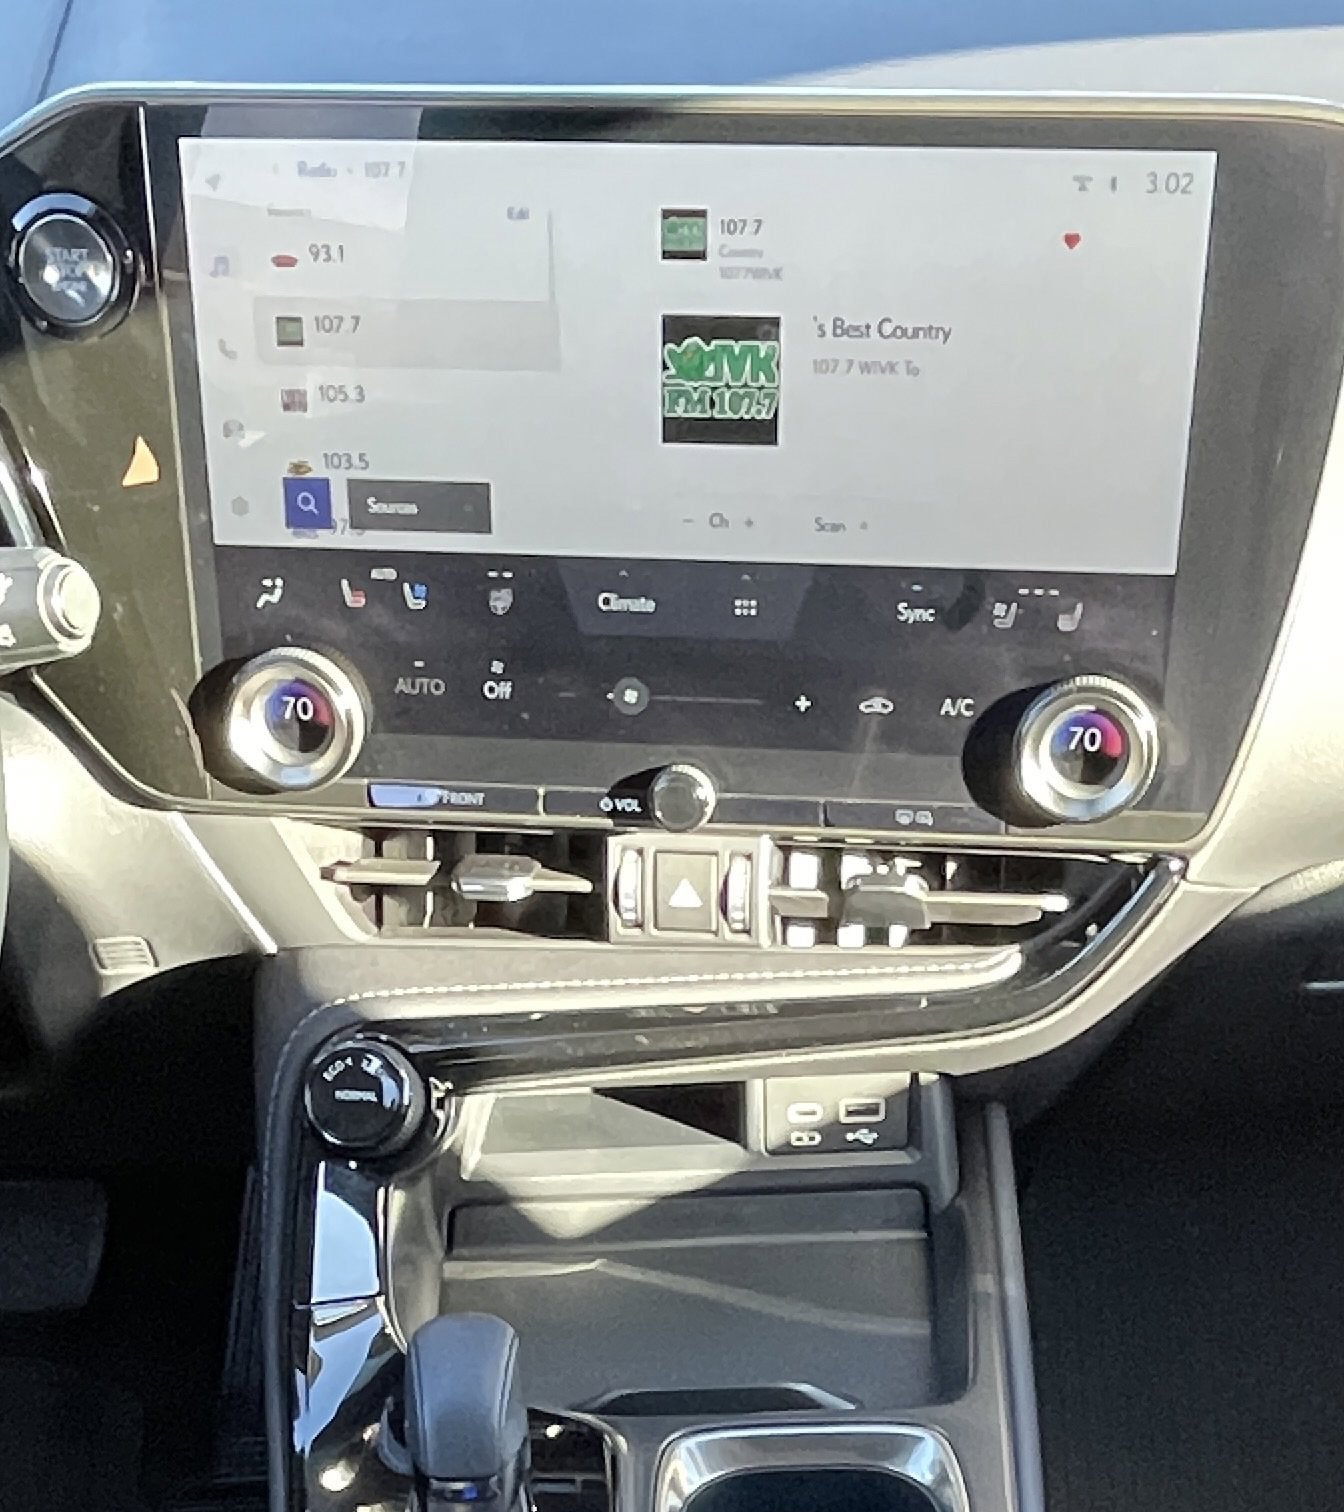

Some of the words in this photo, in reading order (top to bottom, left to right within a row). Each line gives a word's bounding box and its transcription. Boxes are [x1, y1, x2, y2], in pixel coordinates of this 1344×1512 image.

[308, 243, 344, 263] 93.1
[832, 315, 872, 339] Best
[877, 315, 953, 345] Country
[318, 384, 366, 404] 105.3
[323, 452, 370, 471] 103.5
[896, 602, 936, 624] Sync
[394, 676, 446, 696] AUTO
[482, 680, 513, 700] Off
[282, 696, 315, 721] 70
[939, 697, 975, 718] A/C
[1068, 727, 1103, 753] 70
[613, 797, 643, 813] VOL
